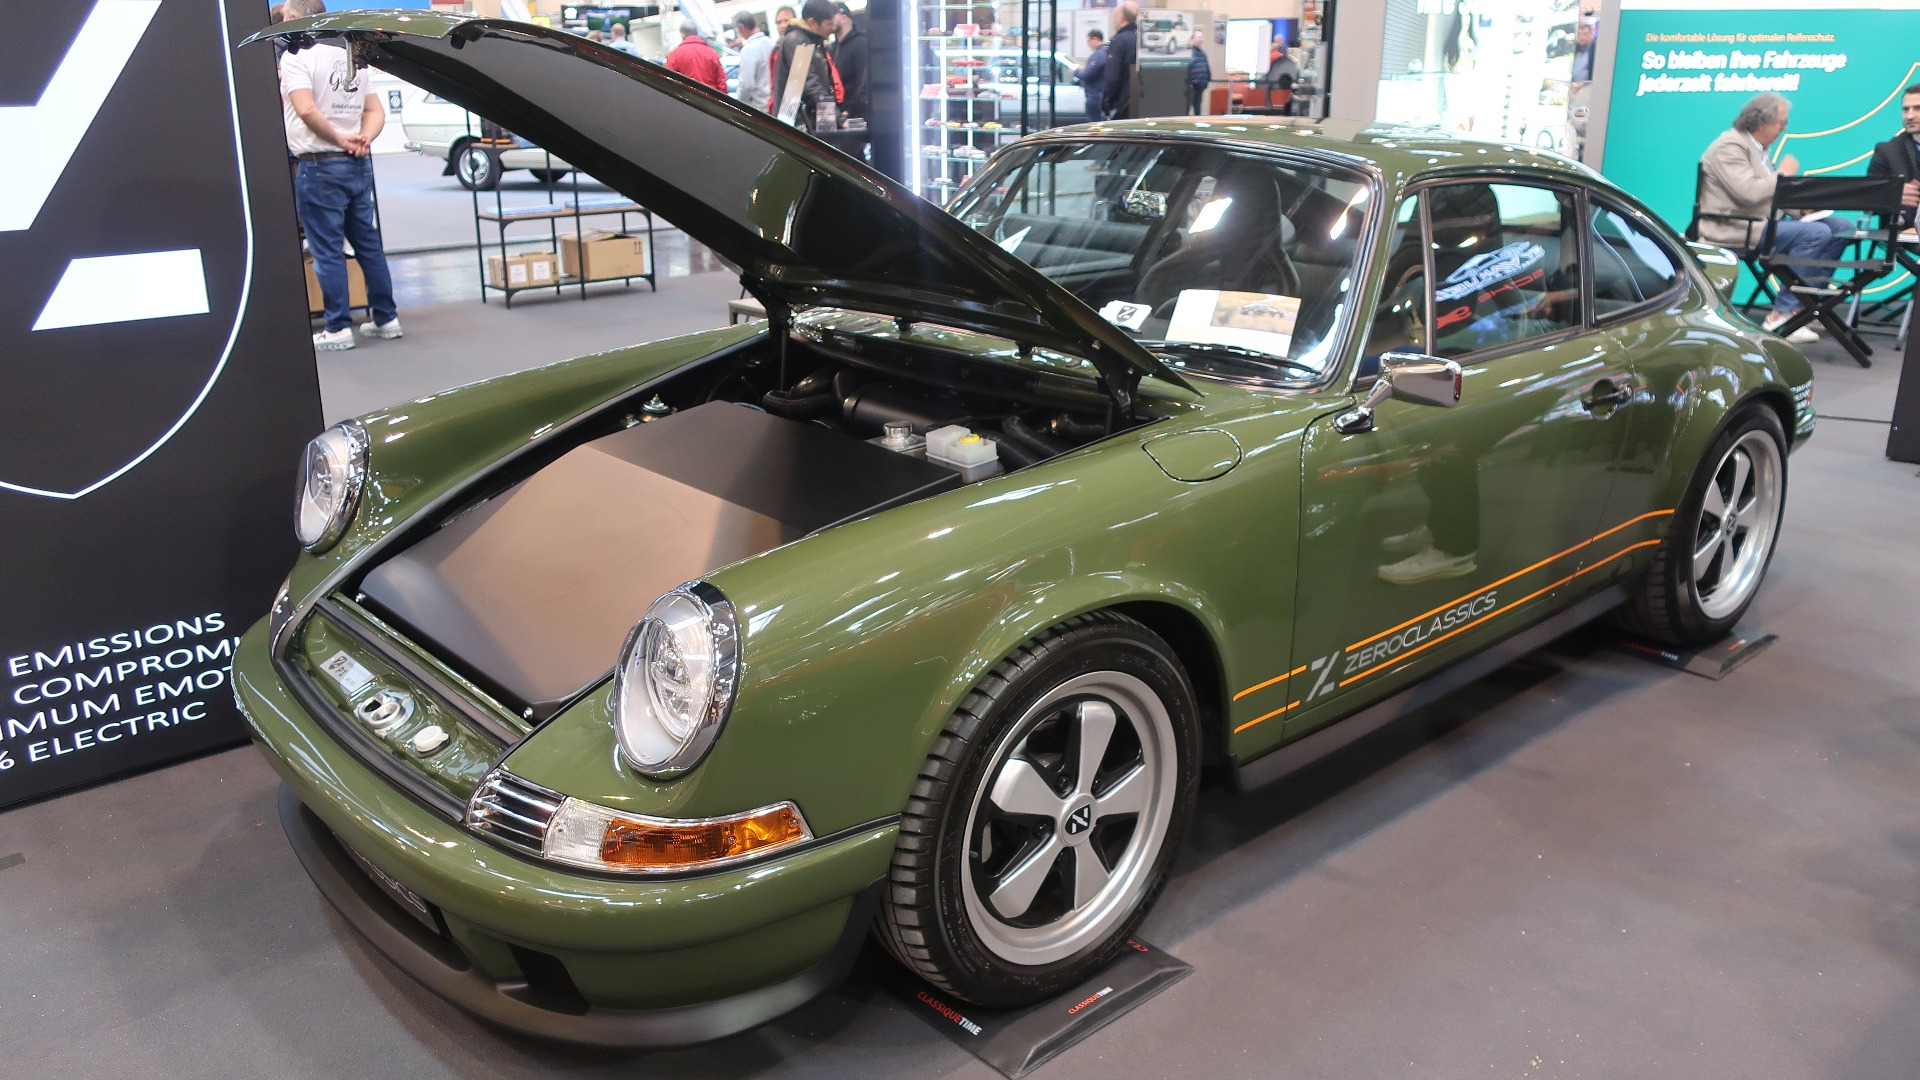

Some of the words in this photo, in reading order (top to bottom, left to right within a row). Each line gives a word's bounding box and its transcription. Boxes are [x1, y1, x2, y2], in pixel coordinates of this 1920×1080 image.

[1646, 33, 1659, 42] Die
[1660, 33, 1706, 42] komfortable
[1707, 33, 1735, 43] Lösung
[1736, 33, 1747, 42] für
[1748, 33, 1786, 43] optimalen
[1641, 50, 1666, 69] So
[1667, 50, 1727, 69] bleiben
[1763, 50, 1847, 72] Fahrzeuge
[1636, 73, 1712, 96] jederzeit
[1714, 73, 1800, 92] fahrbereit!
[9, 612, 226, 677] EMISSIONS
[1343, 590, 1497, 675] ZEROCLASSICS
[29, 701, 207, 763] ELECTRIC
[917, 991, 983, 1036] CLASSIQUETIME
